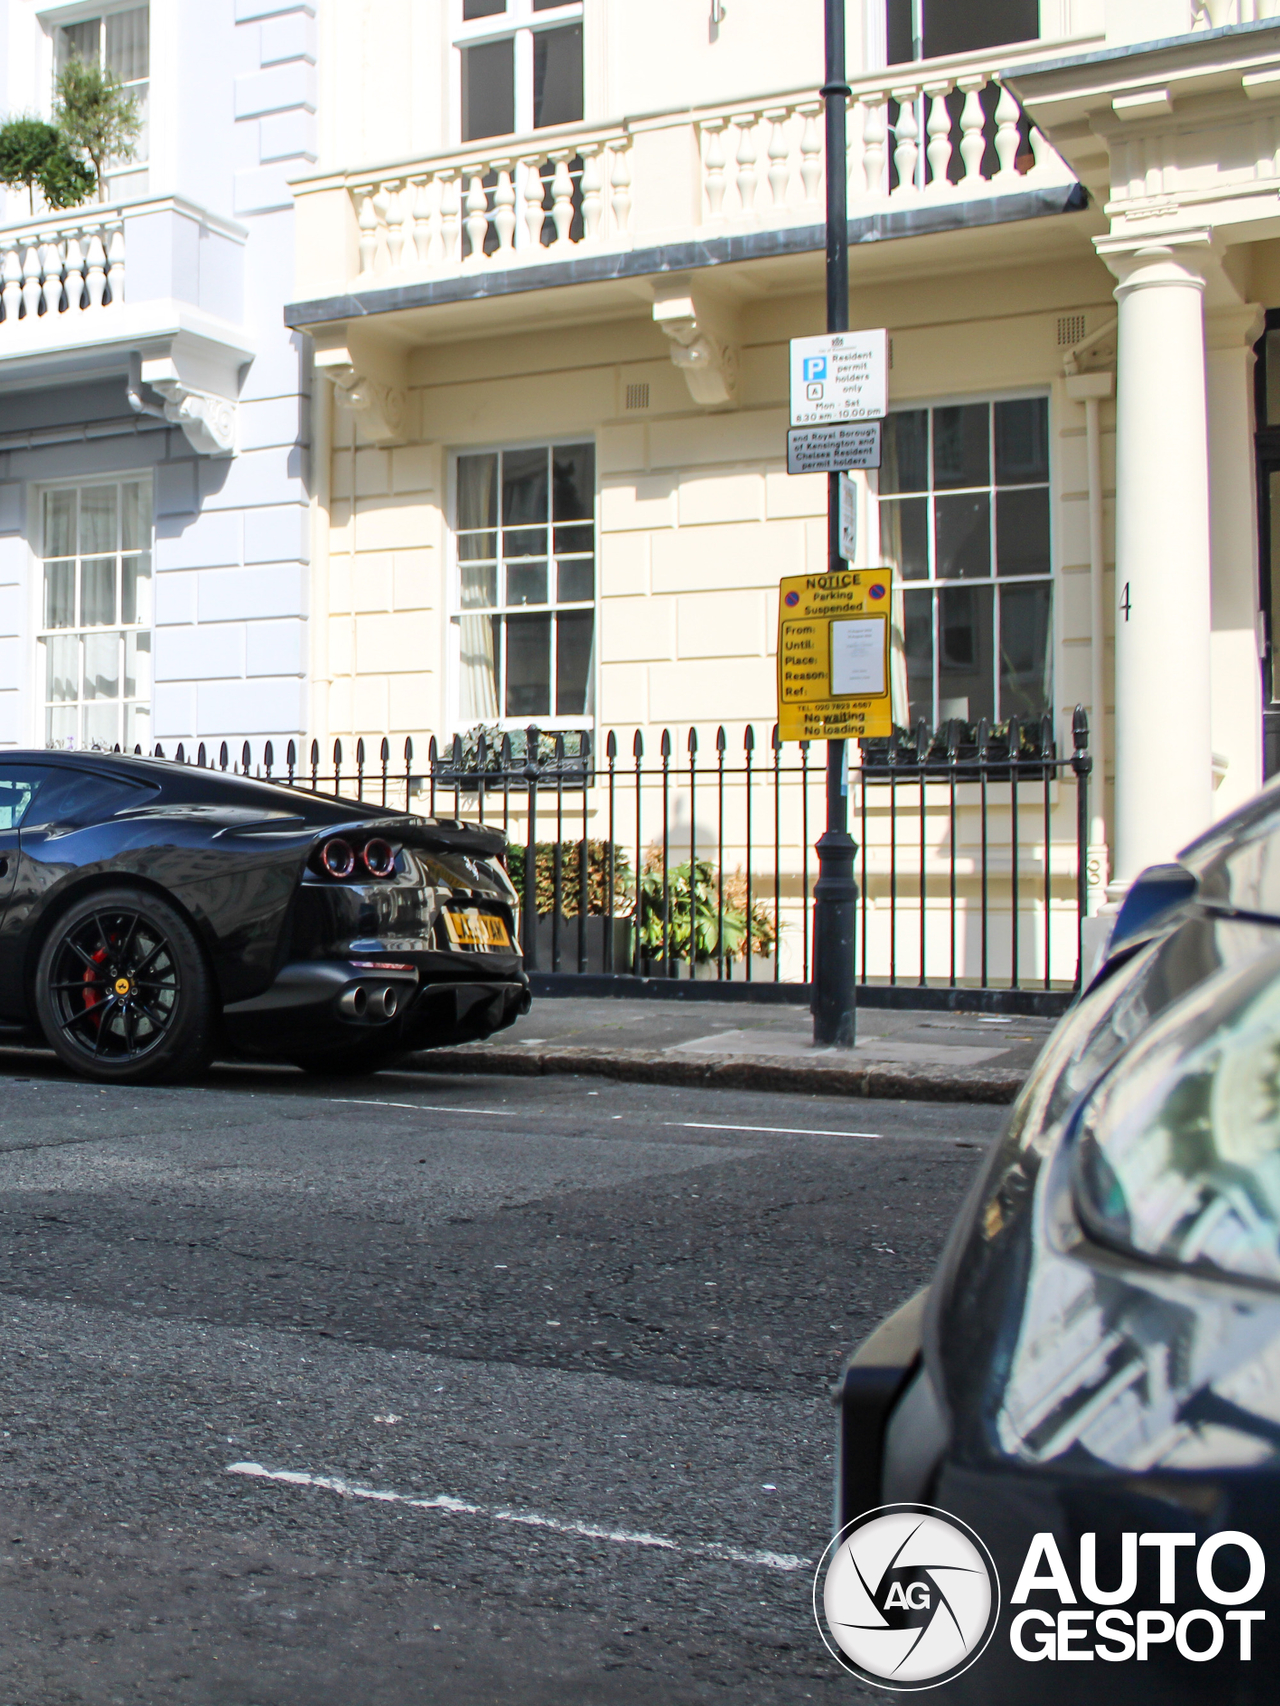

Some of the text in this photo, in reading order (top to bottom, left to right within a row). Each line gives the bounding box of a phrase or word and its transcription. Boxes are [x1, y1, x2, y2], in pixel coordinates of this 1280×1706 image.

[832, 351, 872, 363] Resident
[808, 358, 824, 380] P
[837, 363, 867, 373] permit
[835, 373, 869, 383] holders
[811, 387, 818, 396] A
[842, 384, 863, 393] only
[815, 402, 835, 411] Mon
[844, 399, 860, 408] Sat
[796, 413, 817, 423] 8.30
[839, 408, 865, 418] 10.00
[867, 408, 881, 417] pm
[793, 428, 877, 442] and Royal Borough
[794, 437, 875, 452] of Kensington and
[795, 446, 873, 461] Chelsea Resident
[802, 457, 867, 471] permit holders
[806, 573, 862, 589] NOTICE
[813, 591, 854, 602] Parking
[1119, 581, 1132, 622] 4
[805, 602, 863, 615] Suspended
[785, 625, 816, 636] From:
[785, 640, 815, 651] Until:
[785, 656, 818, 666] Place:
[785, 671, 828, 681] Reason:
[785, 686, 807, 697] Ref:
[804, 711, 865, 723] No waiting
[804, 723, 865, 735] No loading
